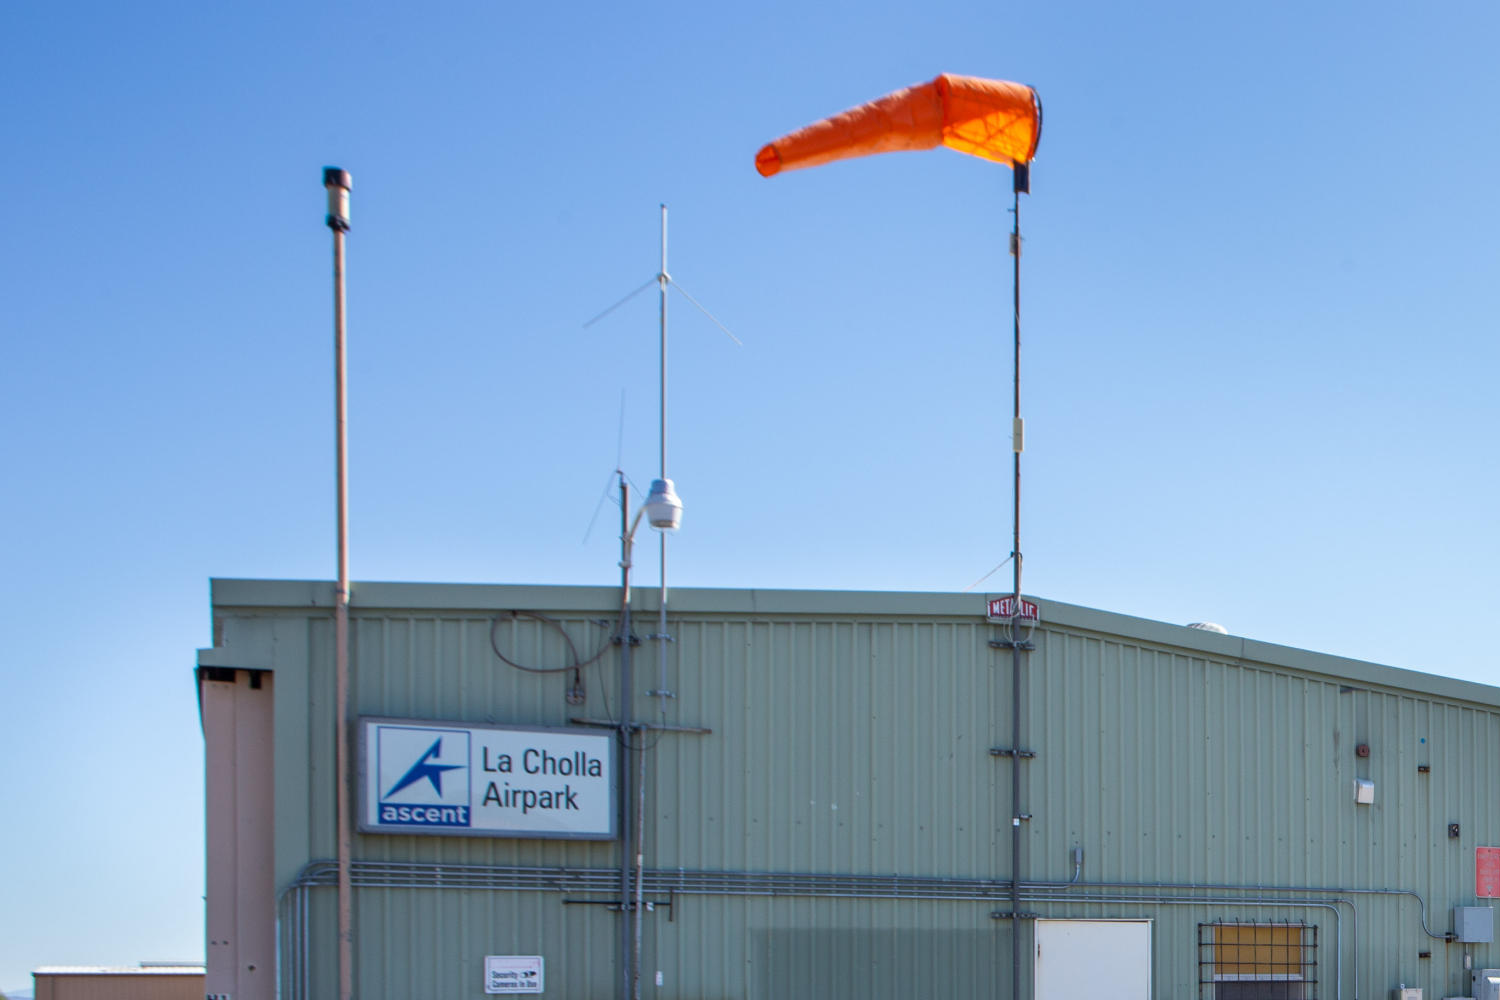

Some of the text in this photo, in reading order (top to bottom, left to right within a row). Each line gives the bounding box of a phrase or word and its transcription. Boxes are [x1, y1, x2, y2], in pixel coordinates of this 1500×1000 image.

[482, 746, 602, 777] La Cholla
[482, 781, 579, 814] Airpark
[382, 804, 468, 823] ascent
